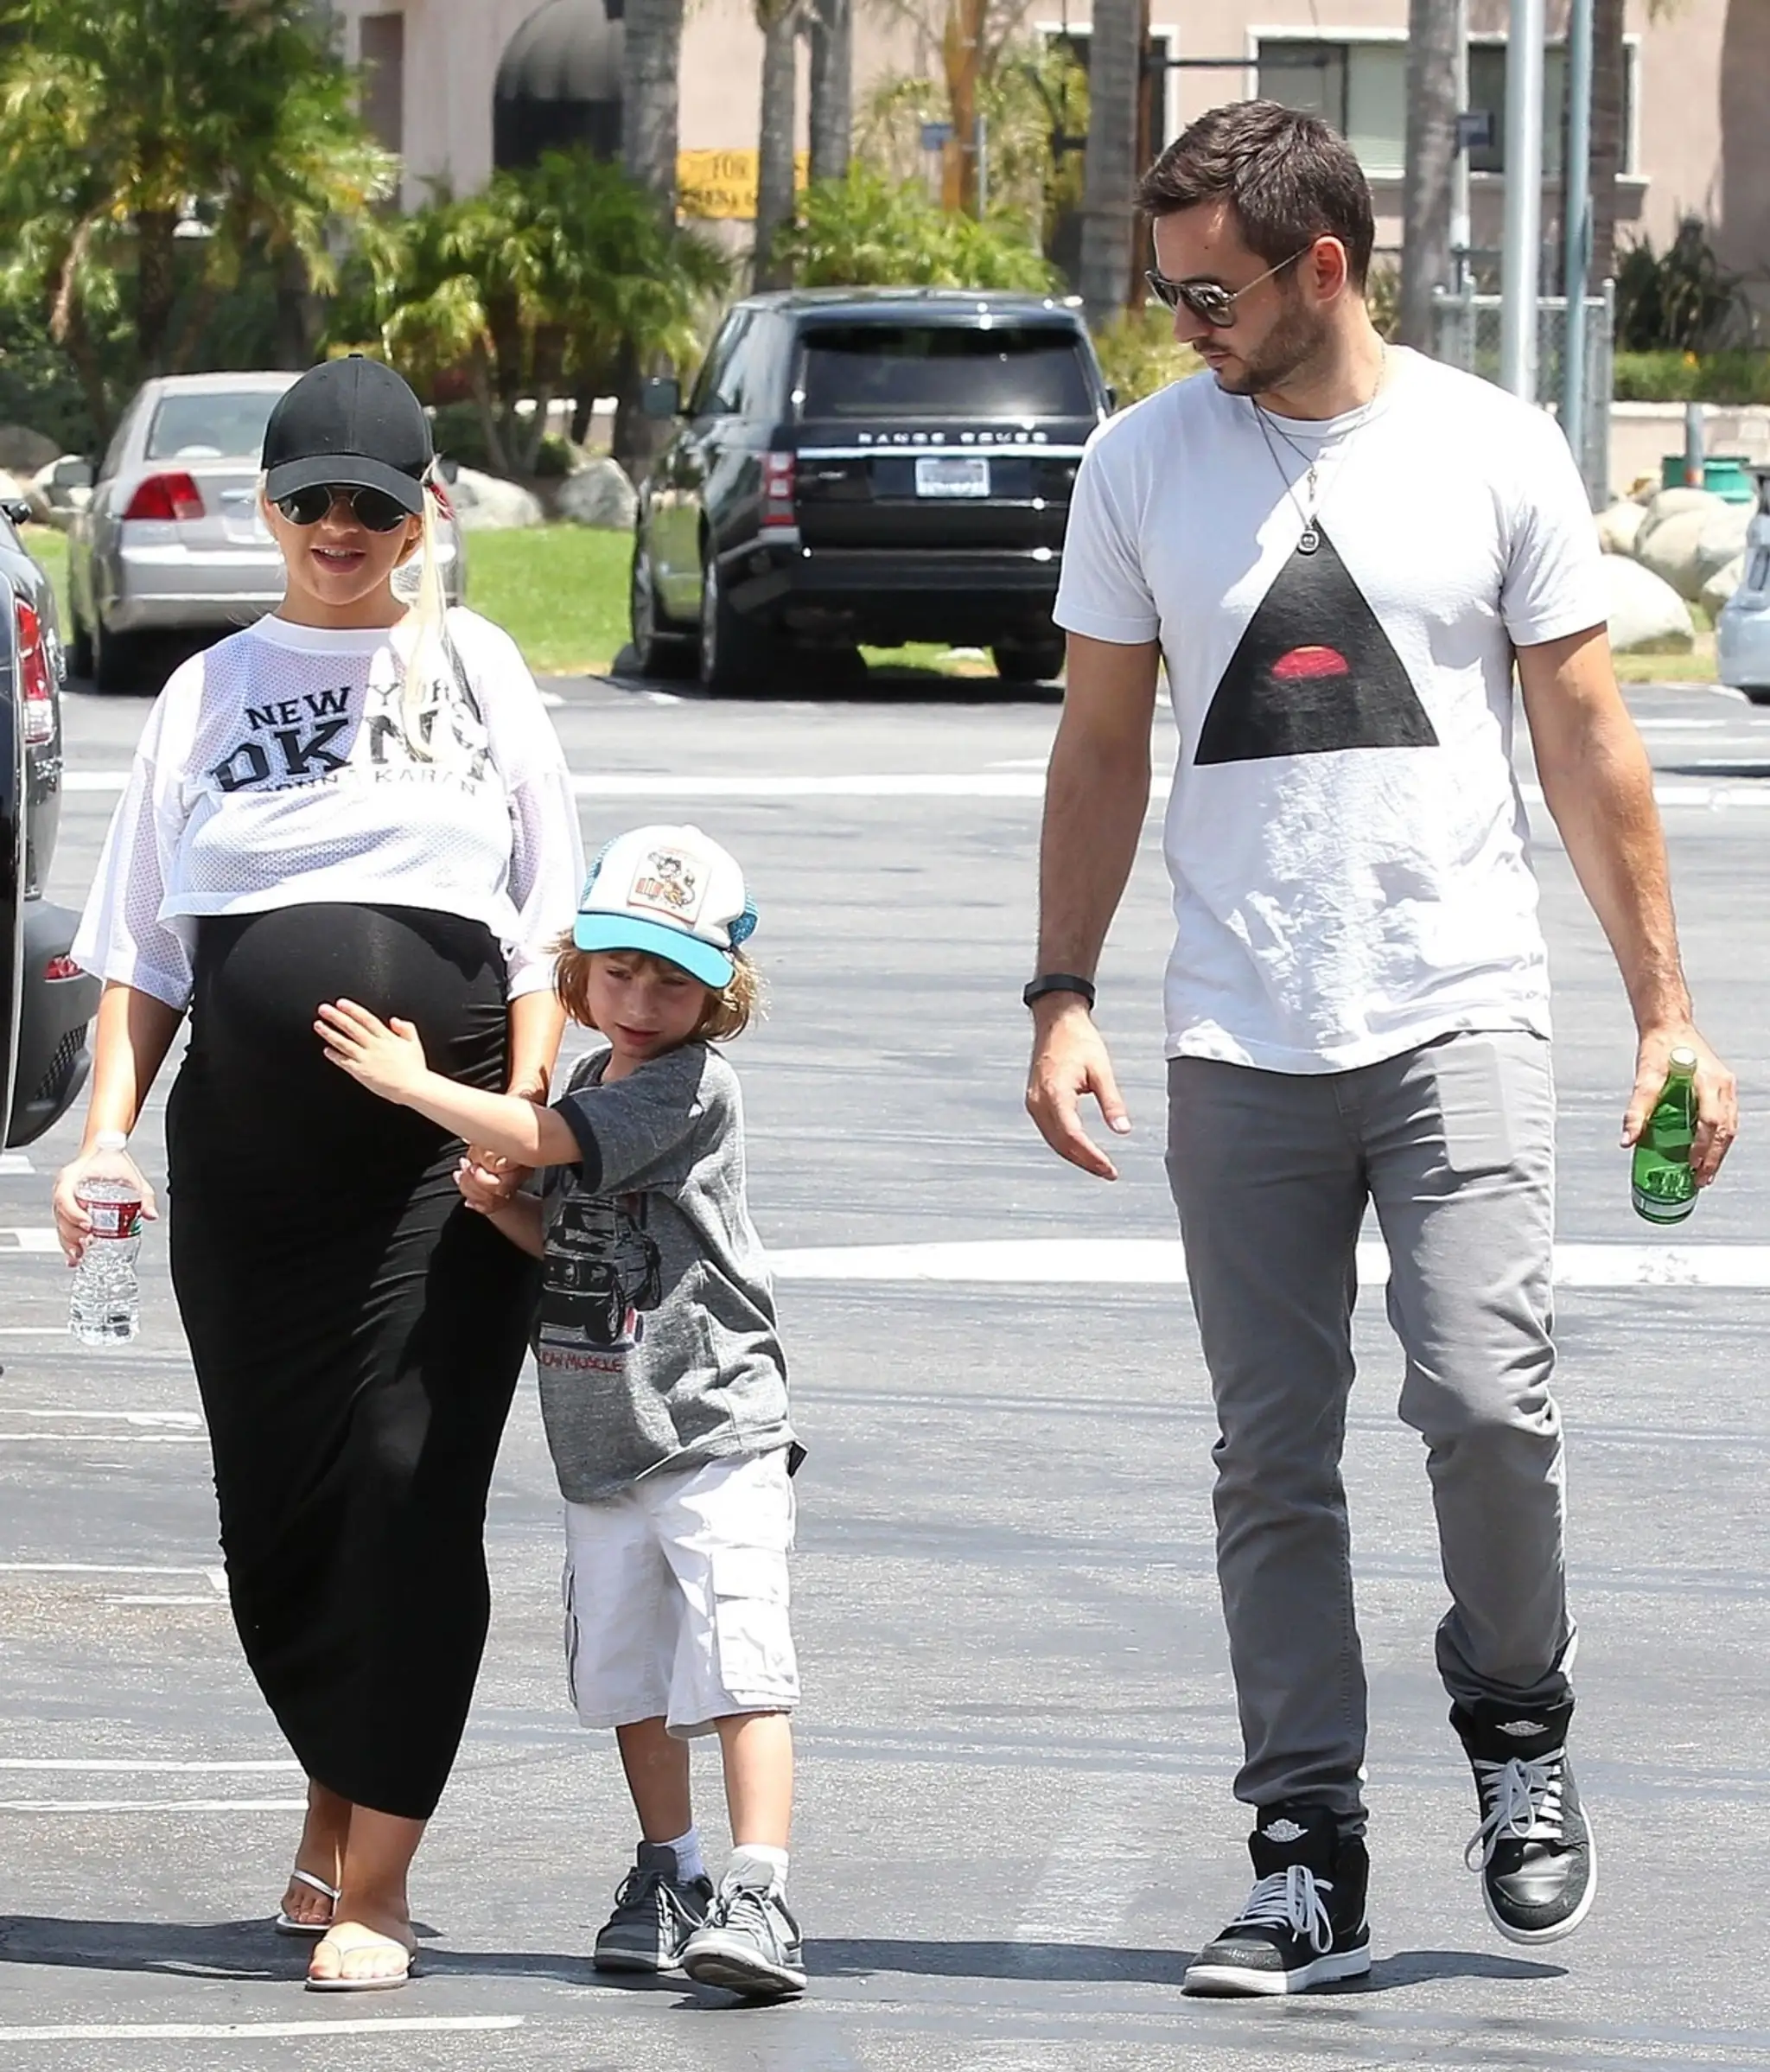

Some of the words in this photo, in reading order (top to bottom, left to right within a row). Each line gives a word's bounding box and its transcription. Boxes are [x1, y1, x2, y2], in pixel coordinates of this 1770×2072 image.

[857, 432, 945, 444] RANGE
[959, 432, 1048, 444] ROVER
[245, 686, 352, 730] NEW
